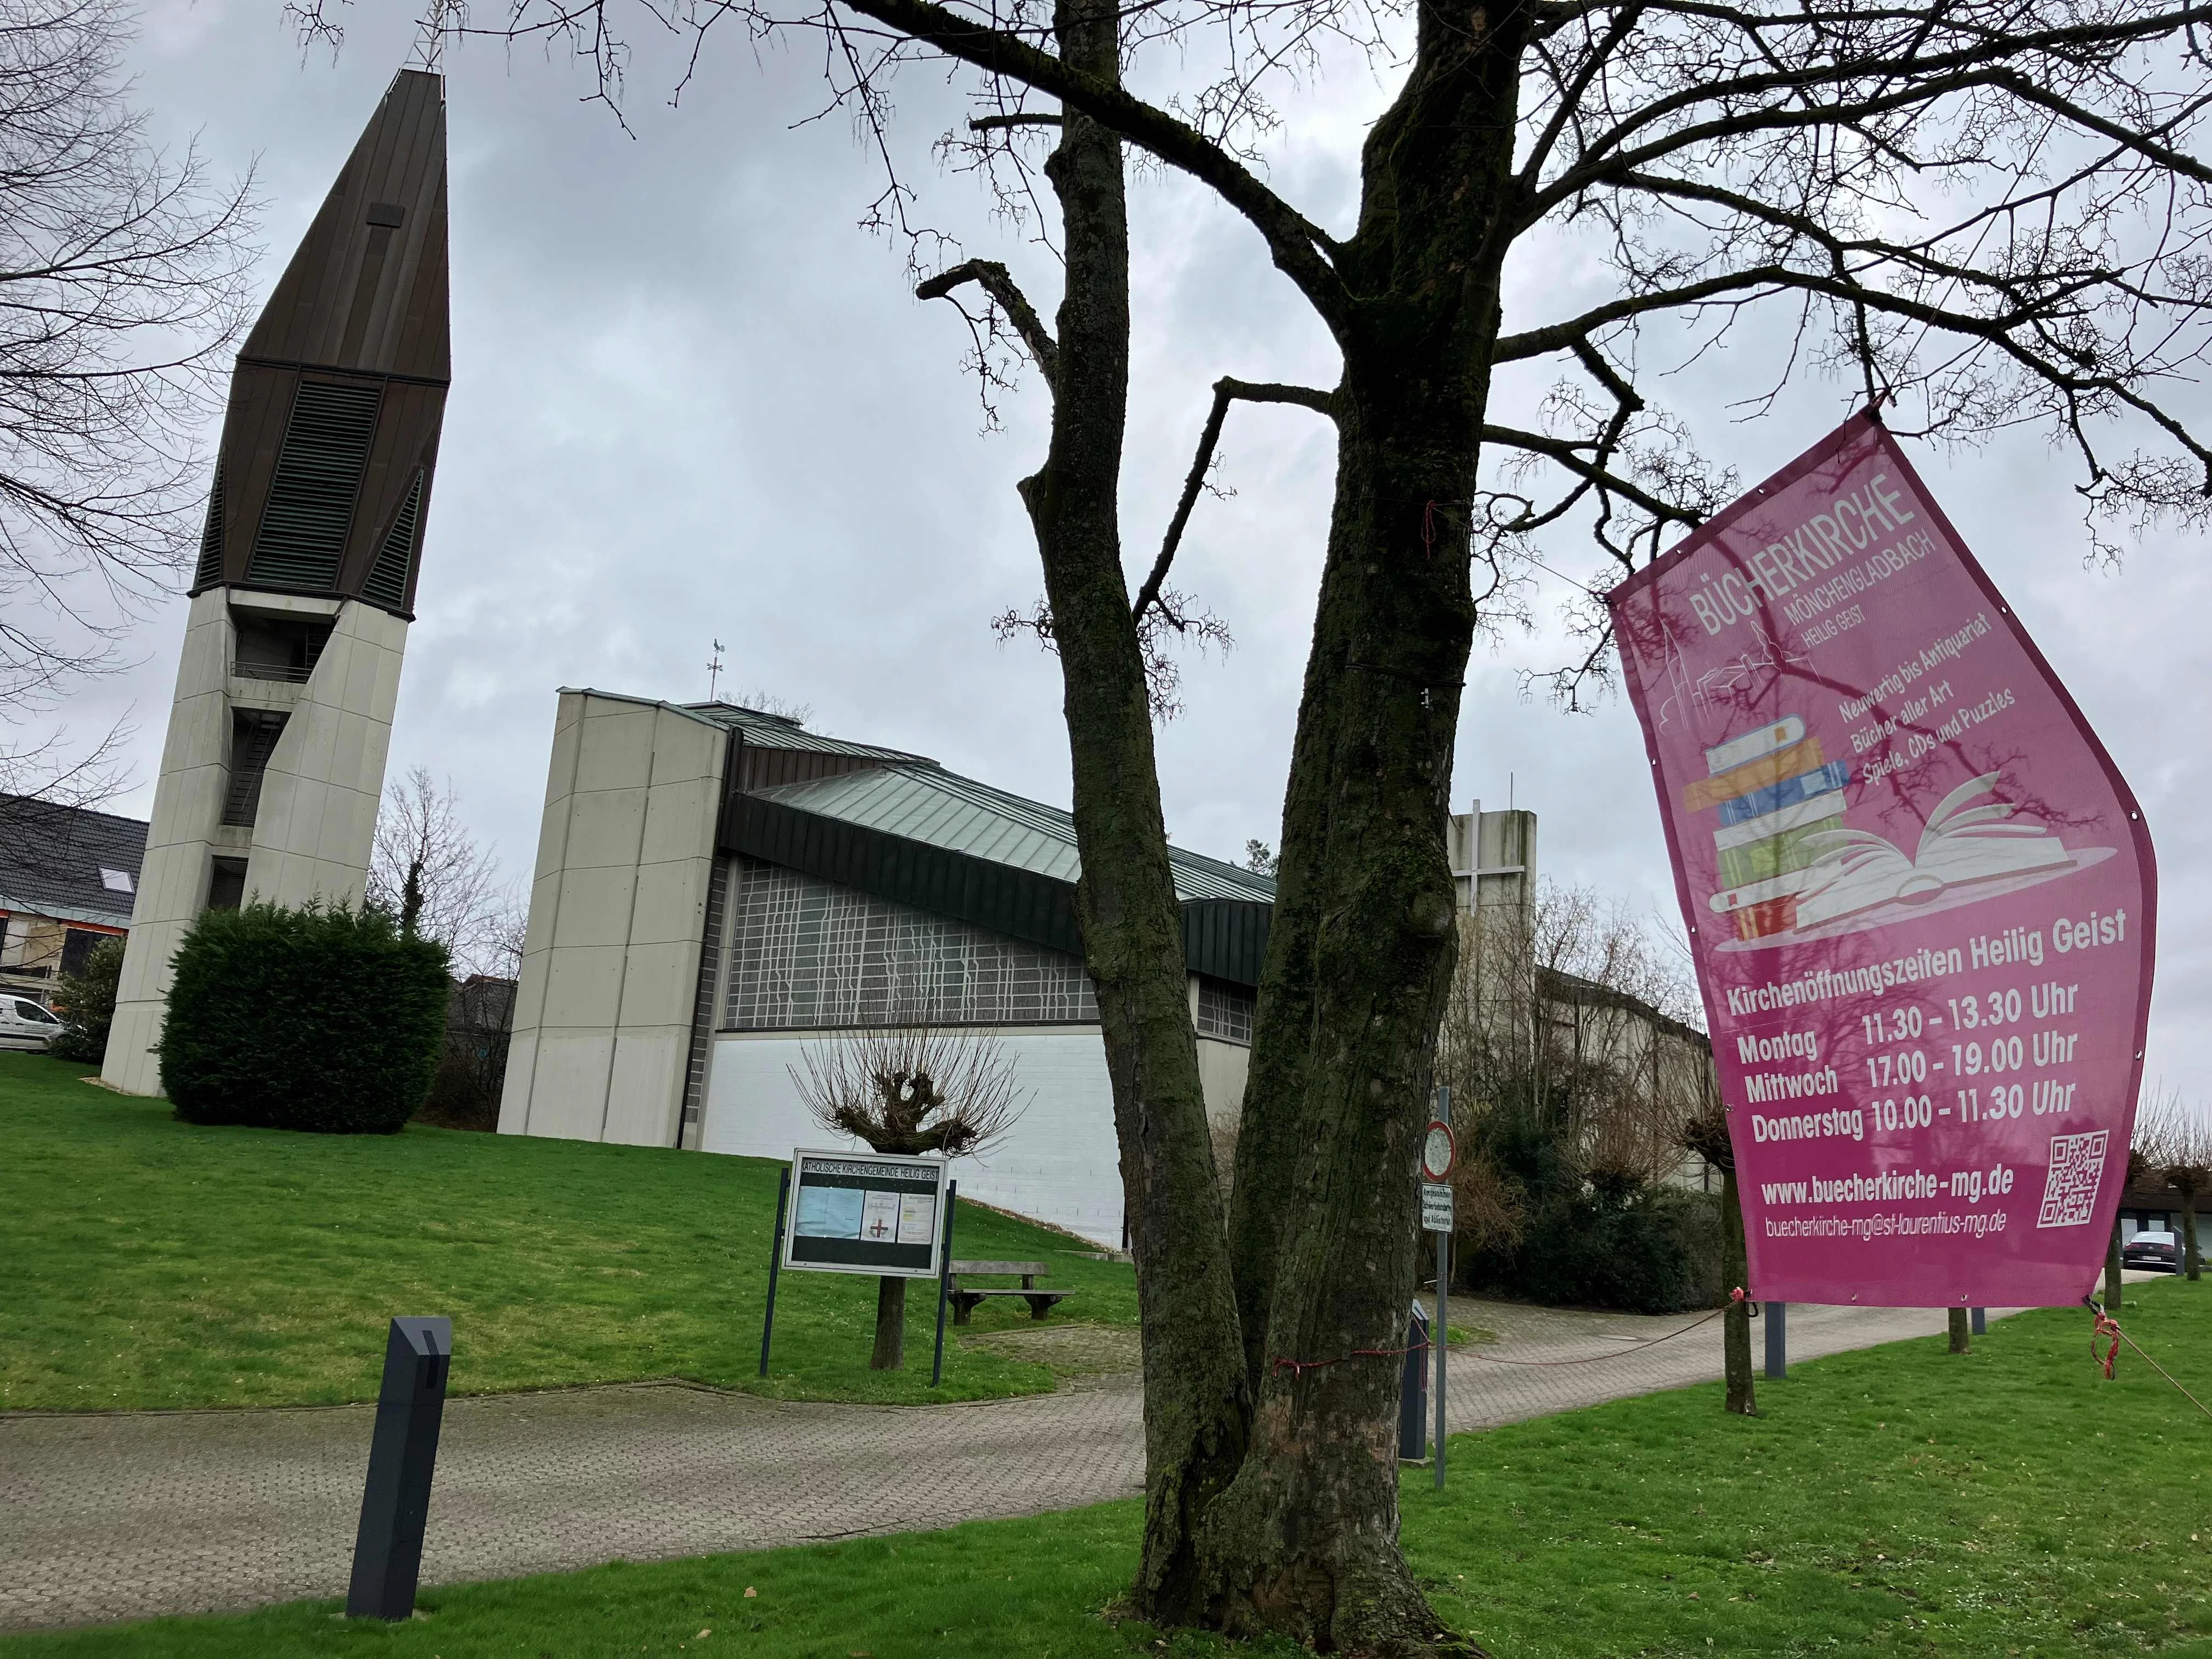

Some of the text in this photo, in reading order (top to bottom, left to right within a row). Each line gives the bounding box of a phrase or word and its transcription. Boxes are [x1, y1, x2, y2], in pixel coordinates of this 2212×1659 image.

[1689, 473, 1915, 636] BÜCHERKIRCHE
[1783, 528, 1936, 626] MÖNCHENGLADBACH
[1801, 605, 1865, 648] HEILIG GEIST
[1839, 612, 1991, 723] Neuwertig bis Antiquariat
[1850, 680, 1954, 753] Bücher aller Art
[1863, 688, 2015, 786] Spiele, CDs und Puzzles
[1726, 909, 2126, 1015] Kirchenöffnungszeiten Heilig Geist
[1737, 1031, 1817, 1064] Montag
[1862, 1006, 1922, 1045] 11.30
[1949, 988, 2022, 1030] 13.30
[2032, 982, 2078, 1018] Uhr
[1745, 1059, 1838, 1103] Mittwoch
[1867, 1050, 1926, 1088] 17.00
[1952, 1035, 2023, 1076] 19.00
[2033, 1030, 2078, 1066] Uhr
[1752, 1108, 1864, 1142] Donnerstag
[1872, 1095, 1932, 1132] 10.00
[1958, 1084, 2024, 1122] 11.30
[2033, 1079, 2075, 1116] Uhr
[842, 1164, 898, 1177] KIRCHENGEMEINDE
[900, 1170, 919, 1178] HEILIG
[921, 1171, 939, 1180] GEIST
